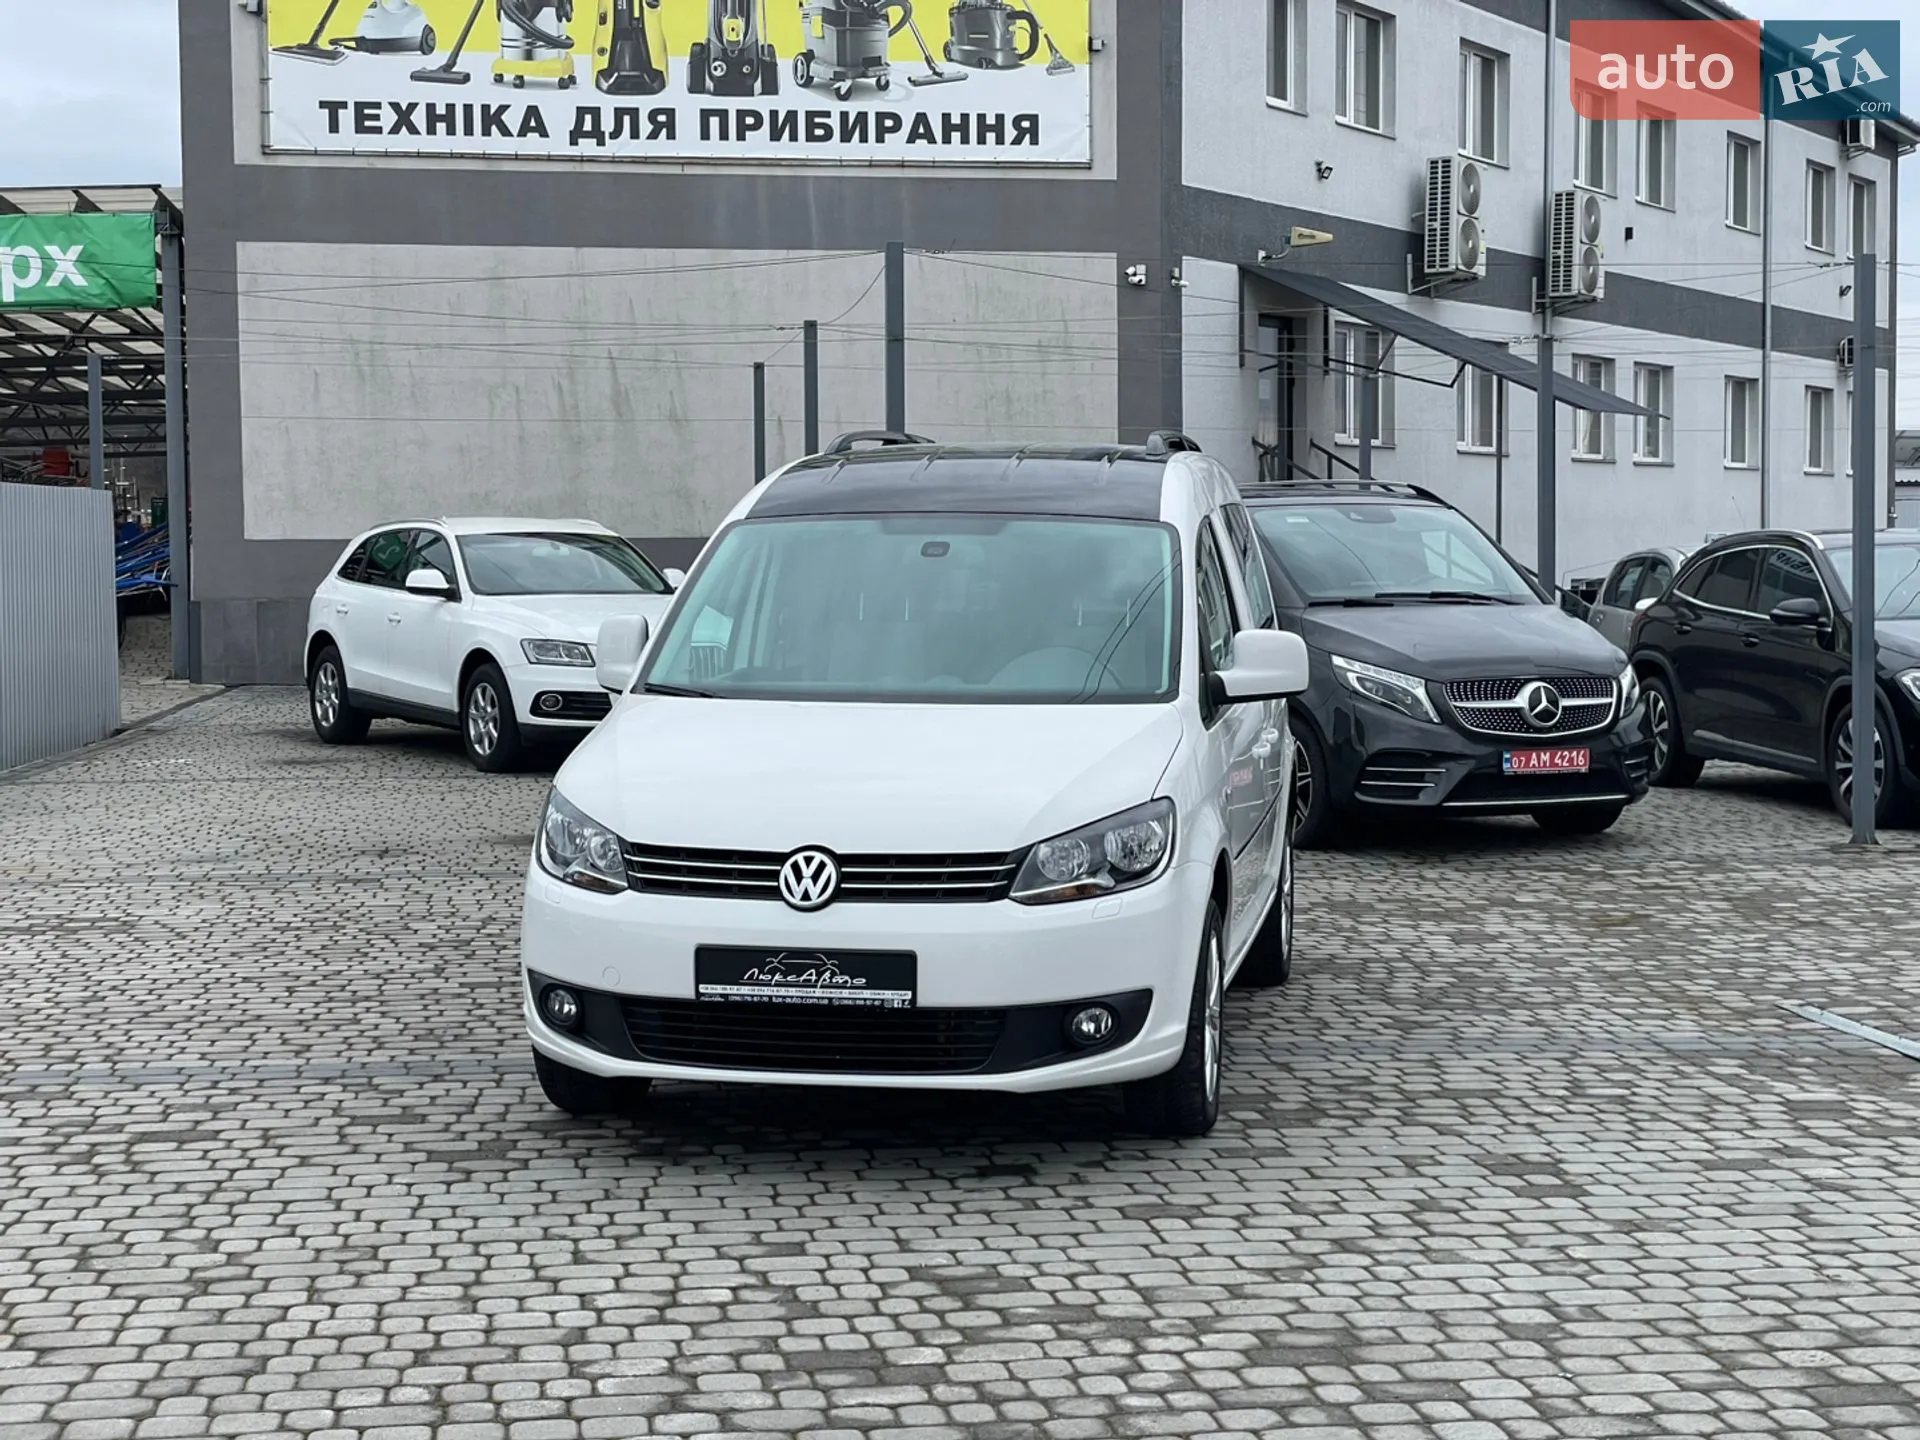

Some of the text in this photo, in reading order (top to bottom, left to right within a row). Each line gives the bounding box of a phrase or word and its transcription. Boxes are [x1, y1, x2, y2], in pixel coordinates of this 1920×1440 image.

[318, 100, 1040, 147] ТЕХНІКА ДЛЯ ПРИБИРАННЯ
[1511, 750, 1585, 768] 07 AM 4216
